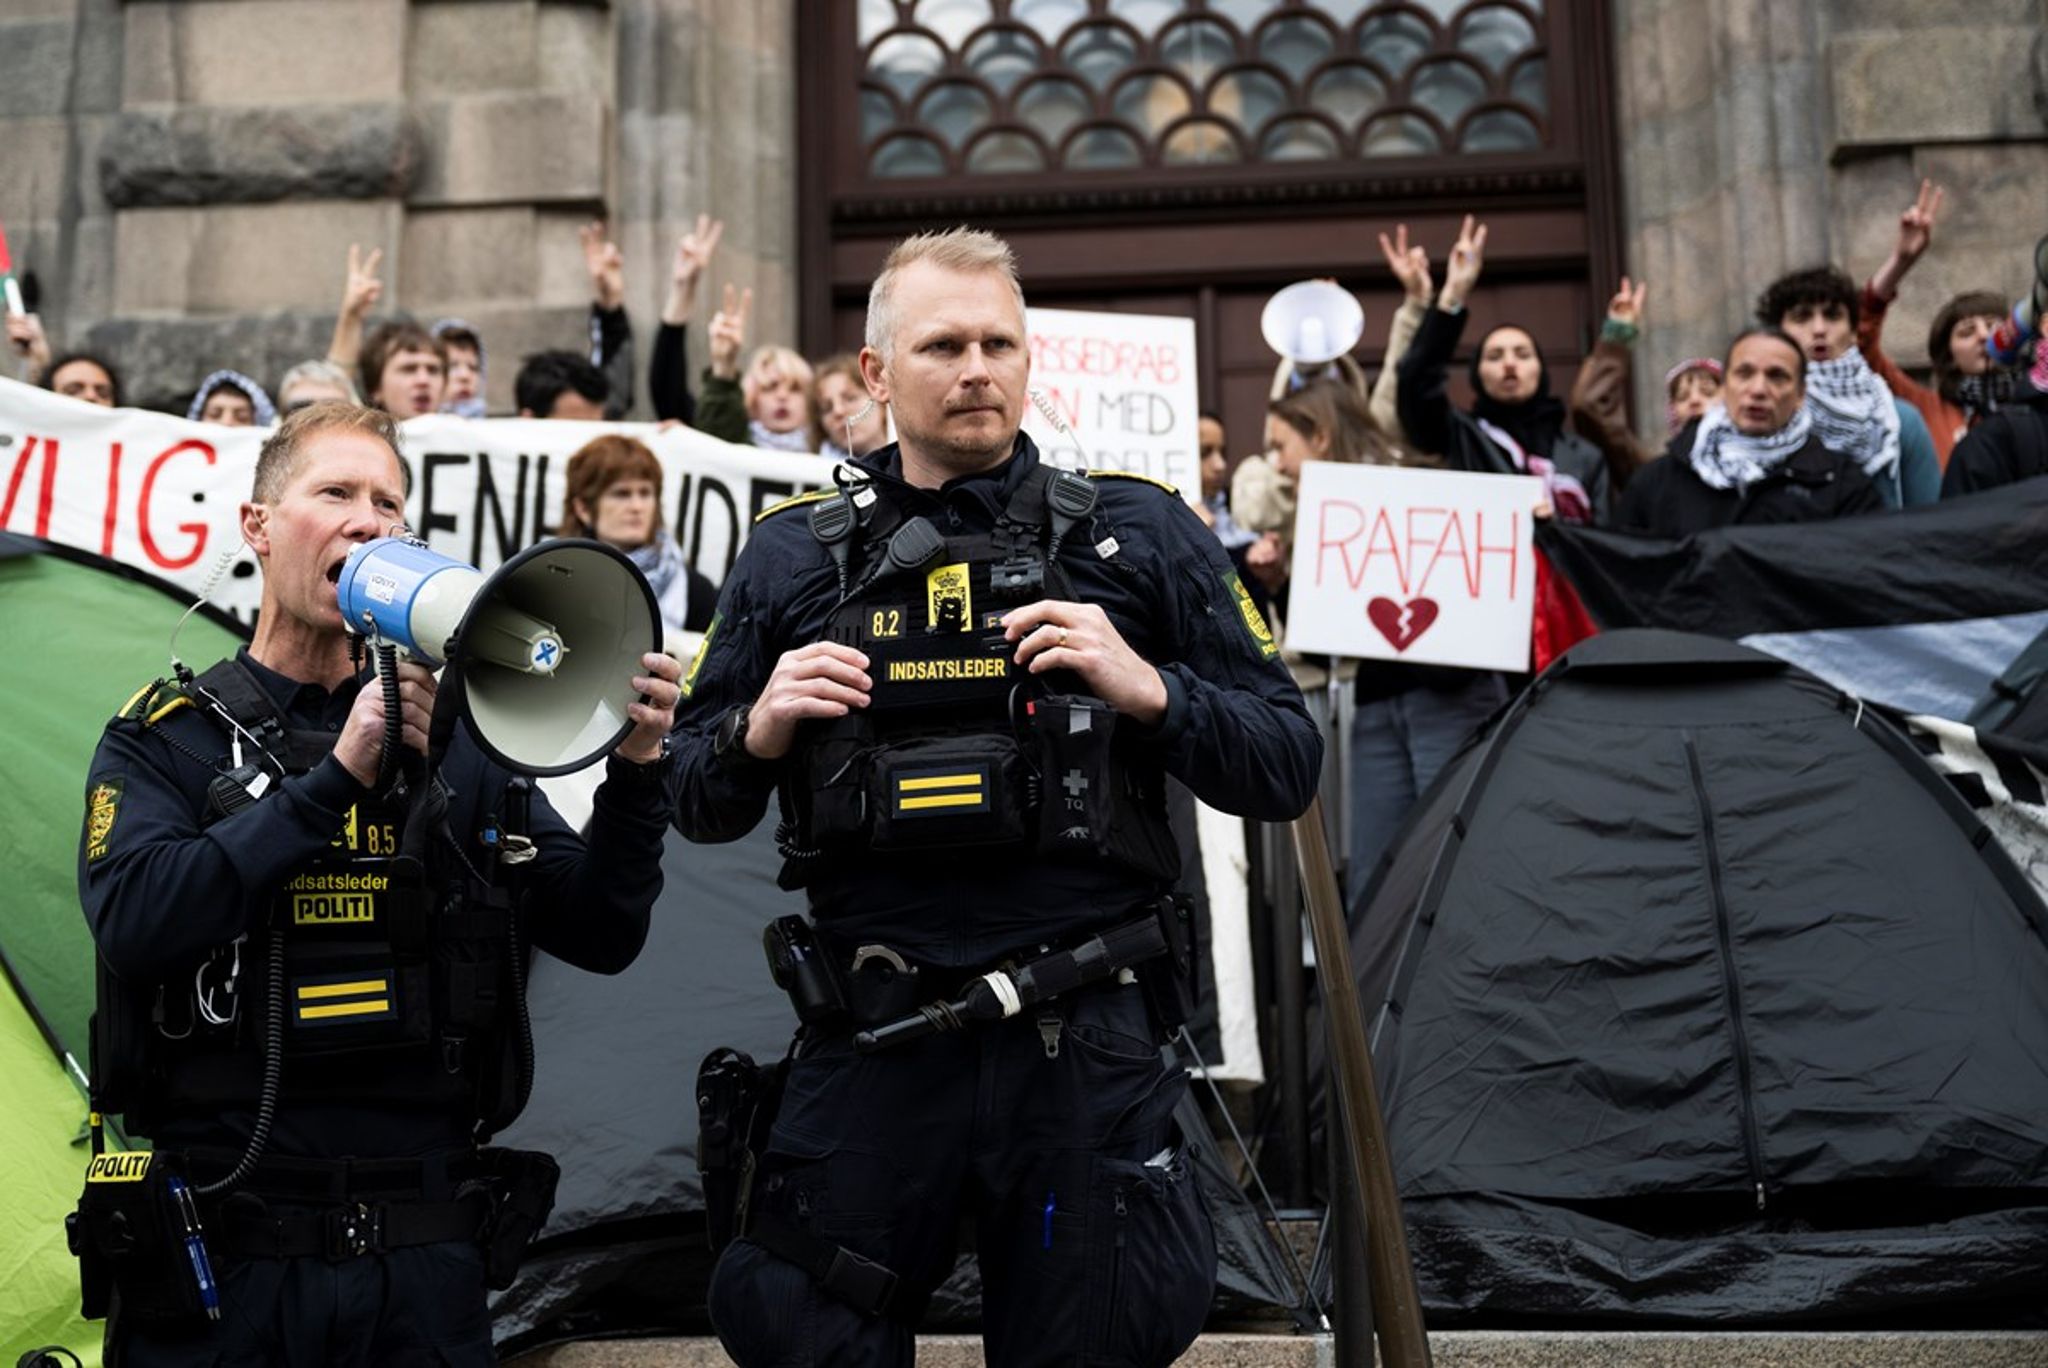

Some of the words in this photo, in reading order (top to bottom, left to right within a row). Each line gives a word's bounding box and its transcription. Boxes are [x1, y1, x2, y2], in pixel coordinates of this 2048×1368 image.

[1097, 391, 1176, 436] MED
[1316, 499, 1519, 600] RAFAH
[872, 609, 899, 637] 8.2
[889, 658, 1006, 681] INDSATSLEDER
[1064, 797, 1084, 812] TQ
[367, 824, 396, 855] 8.5
[284, 872, 389, 891] dsatsleder
[298, 896, 370, 920] POLITI
[91, 1155, 149, 1178] POLITI
